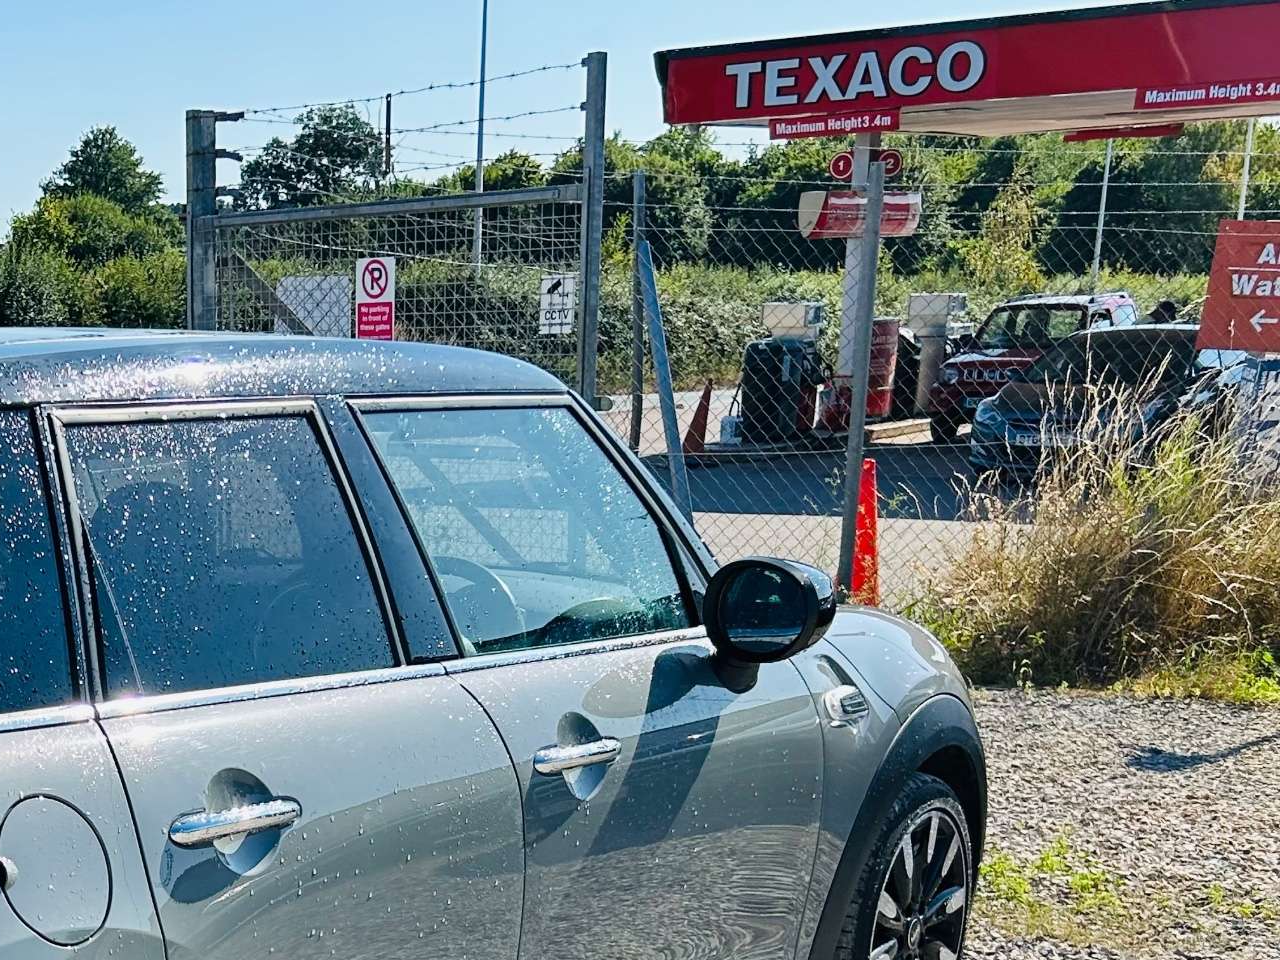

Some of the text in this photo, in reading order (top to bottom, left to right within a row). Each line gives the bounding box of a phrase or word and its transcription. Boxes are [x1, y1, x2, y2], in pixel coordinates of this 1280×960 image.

[725, 40, 986, 108] TEXACO
[1145, 88, 1206, 103] Maximum
[1209, 83, 1252, 100] Height
[775, 122, 826, 135] Maximum
[827, 117, 862, 131] Height
[837, 160, 845, 171] 1
[545, 310, 569, 320] CCTV
